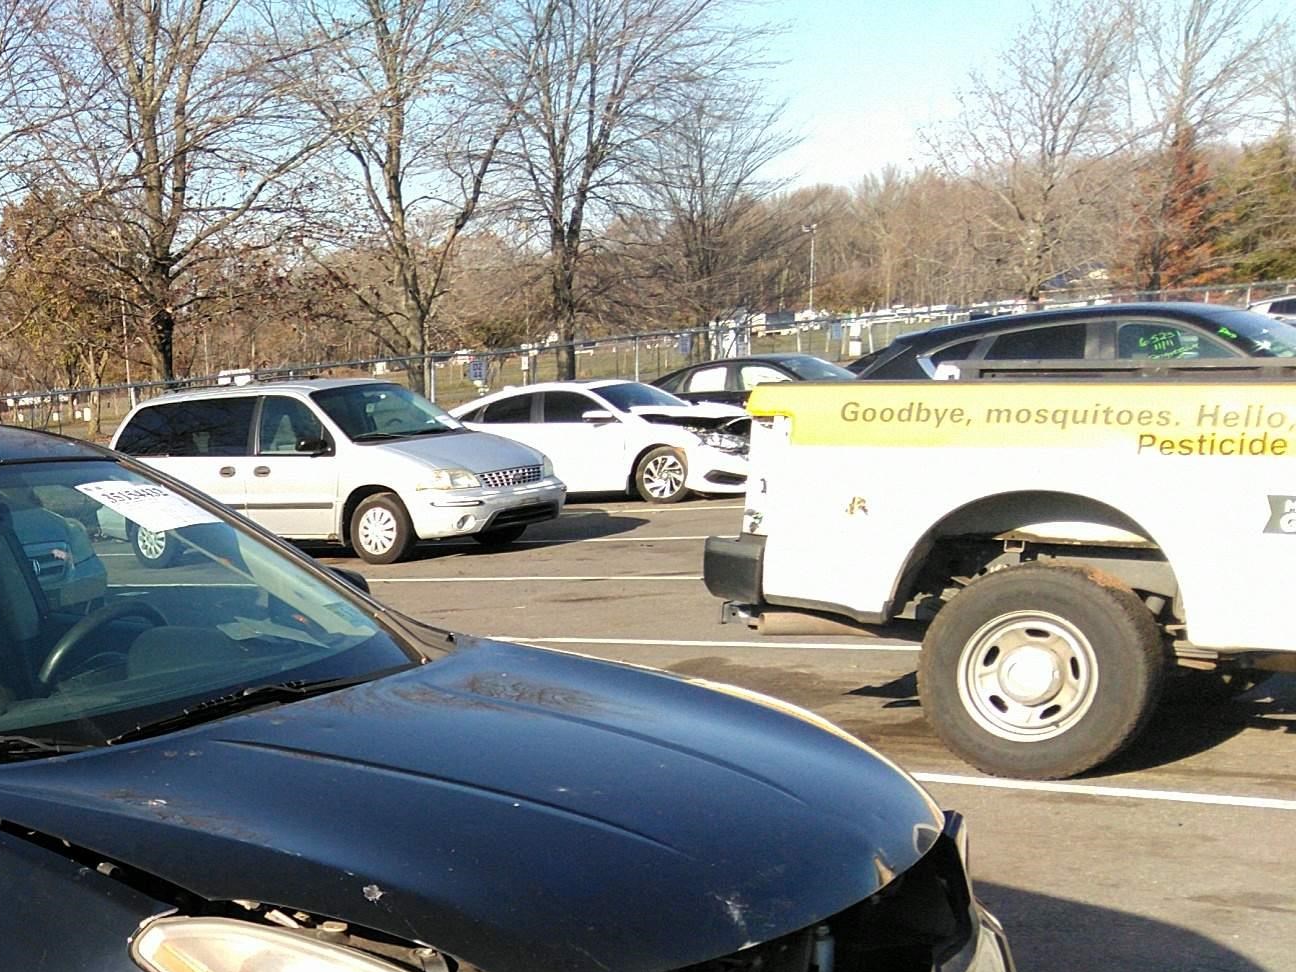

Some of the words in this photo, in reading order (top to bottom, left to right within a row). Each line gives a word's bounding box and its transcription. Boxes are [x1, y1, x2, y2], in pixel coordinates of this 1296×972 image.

[840, 401, 972, 429] Goodbye,
[985, 403, 1181, 430] mosquitoes.
[1196, 404, 1296, 431] Hello,
[1137, 431, 1288, 456] Pesticide
